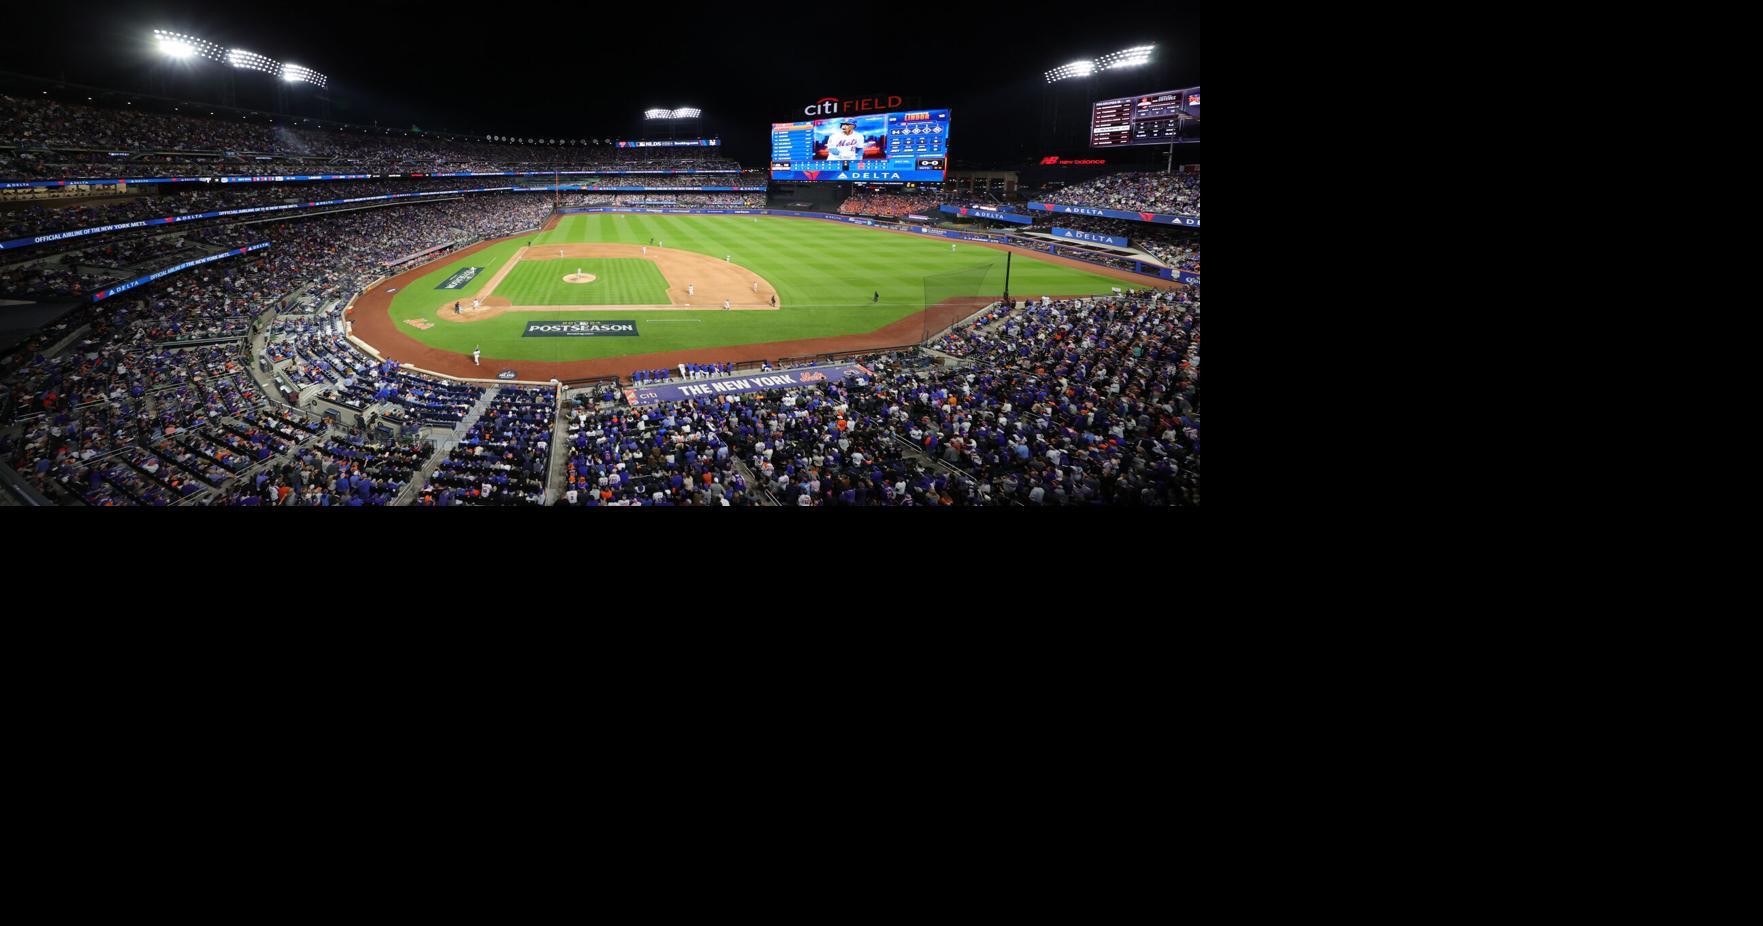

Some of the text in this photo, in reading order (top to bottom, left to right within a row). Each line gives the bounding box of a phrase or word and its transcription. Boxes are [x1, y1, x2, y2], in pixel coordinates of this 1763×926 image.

[804, 95, 902, 116] citi FIELD
[981, 212, 1004, 220] DELTA
[35, 233, 62, 243] OFFICIAL
[62, 230, 83, 239] AIRLINE
[1075, 231, 1113, 243] DELTA
[116, 280, 139, 293] DELTA
[678, 384, 712, 396] THE
[711, 379, 752, 392] NEW
[750, 374, 797, 388] YORK
